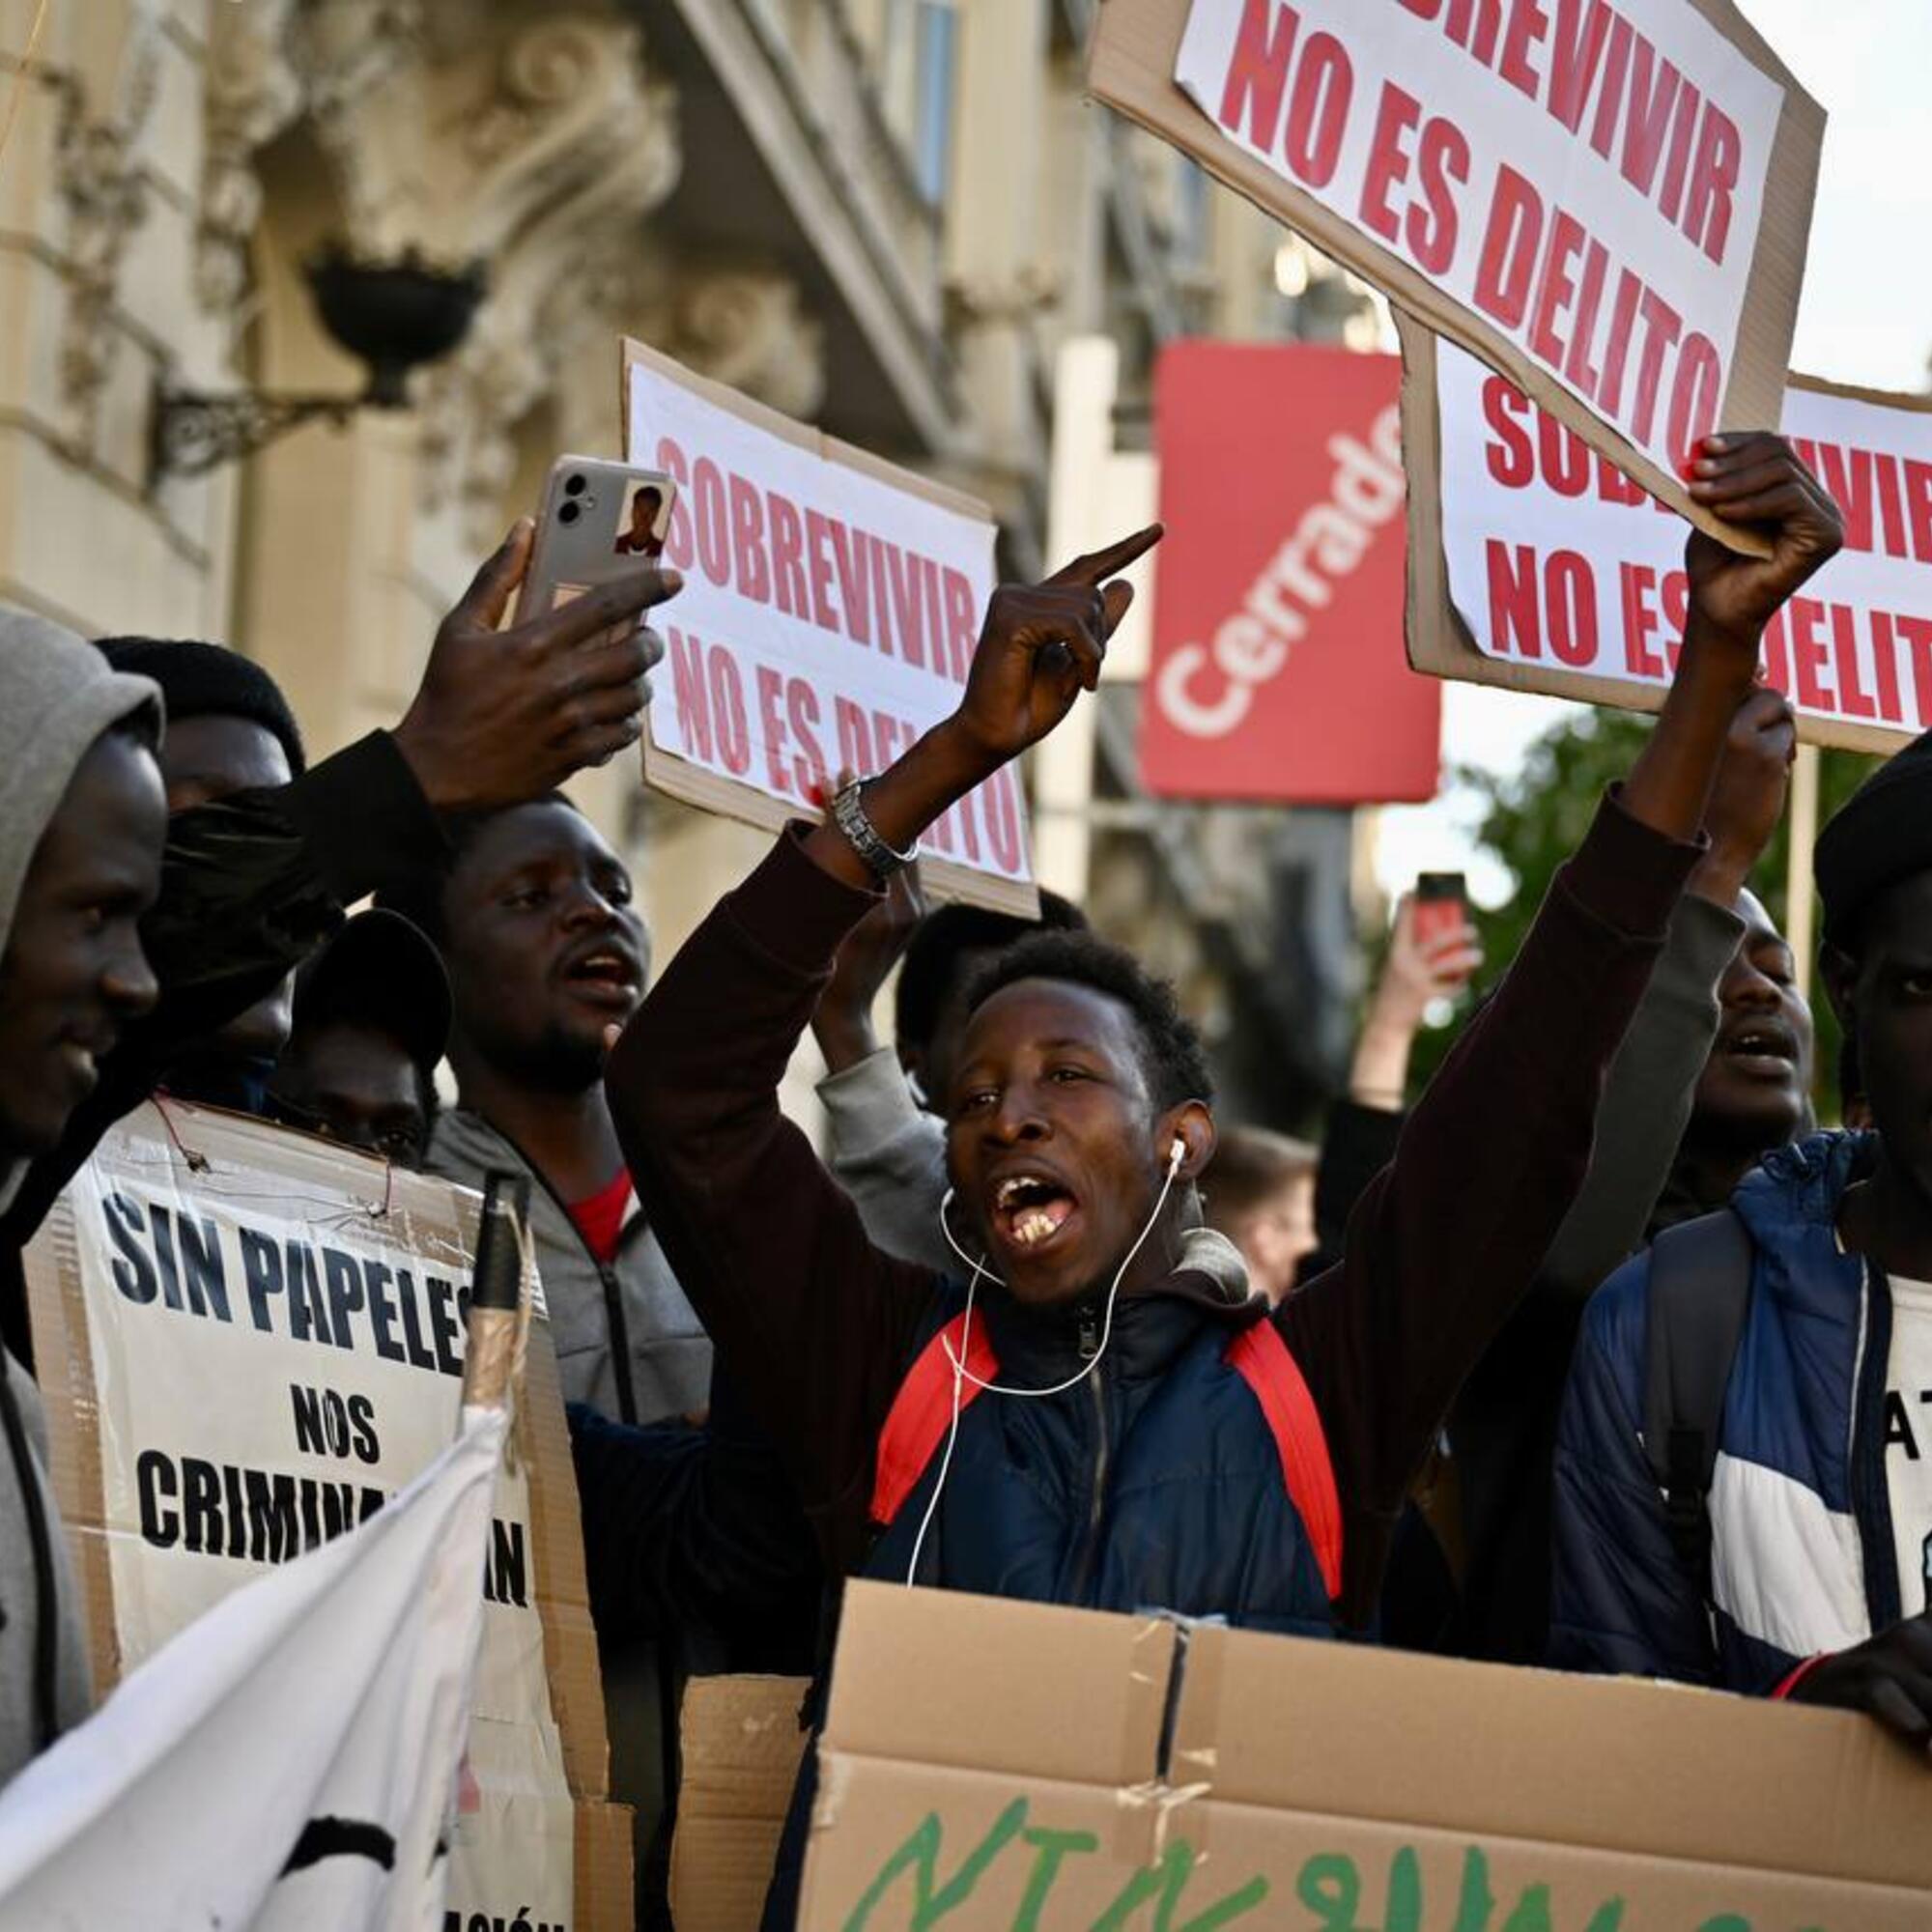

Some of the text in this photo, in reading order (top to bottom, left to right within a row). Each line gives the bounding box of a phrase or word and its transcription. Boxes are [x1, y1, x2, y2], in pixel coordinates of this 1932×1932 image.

[1219, 0, 1721, 481] NO ES DELITO
[657, 437, 976, 686] SOBREVIVIR
[1486, 538, 1599, 668] NO
[668, 627, 750, 777] NO
[757, 664, 823, 807] ES
[102, 1192, 234, 1323] SIN
[290, 1383, 381, 1464] NOS
